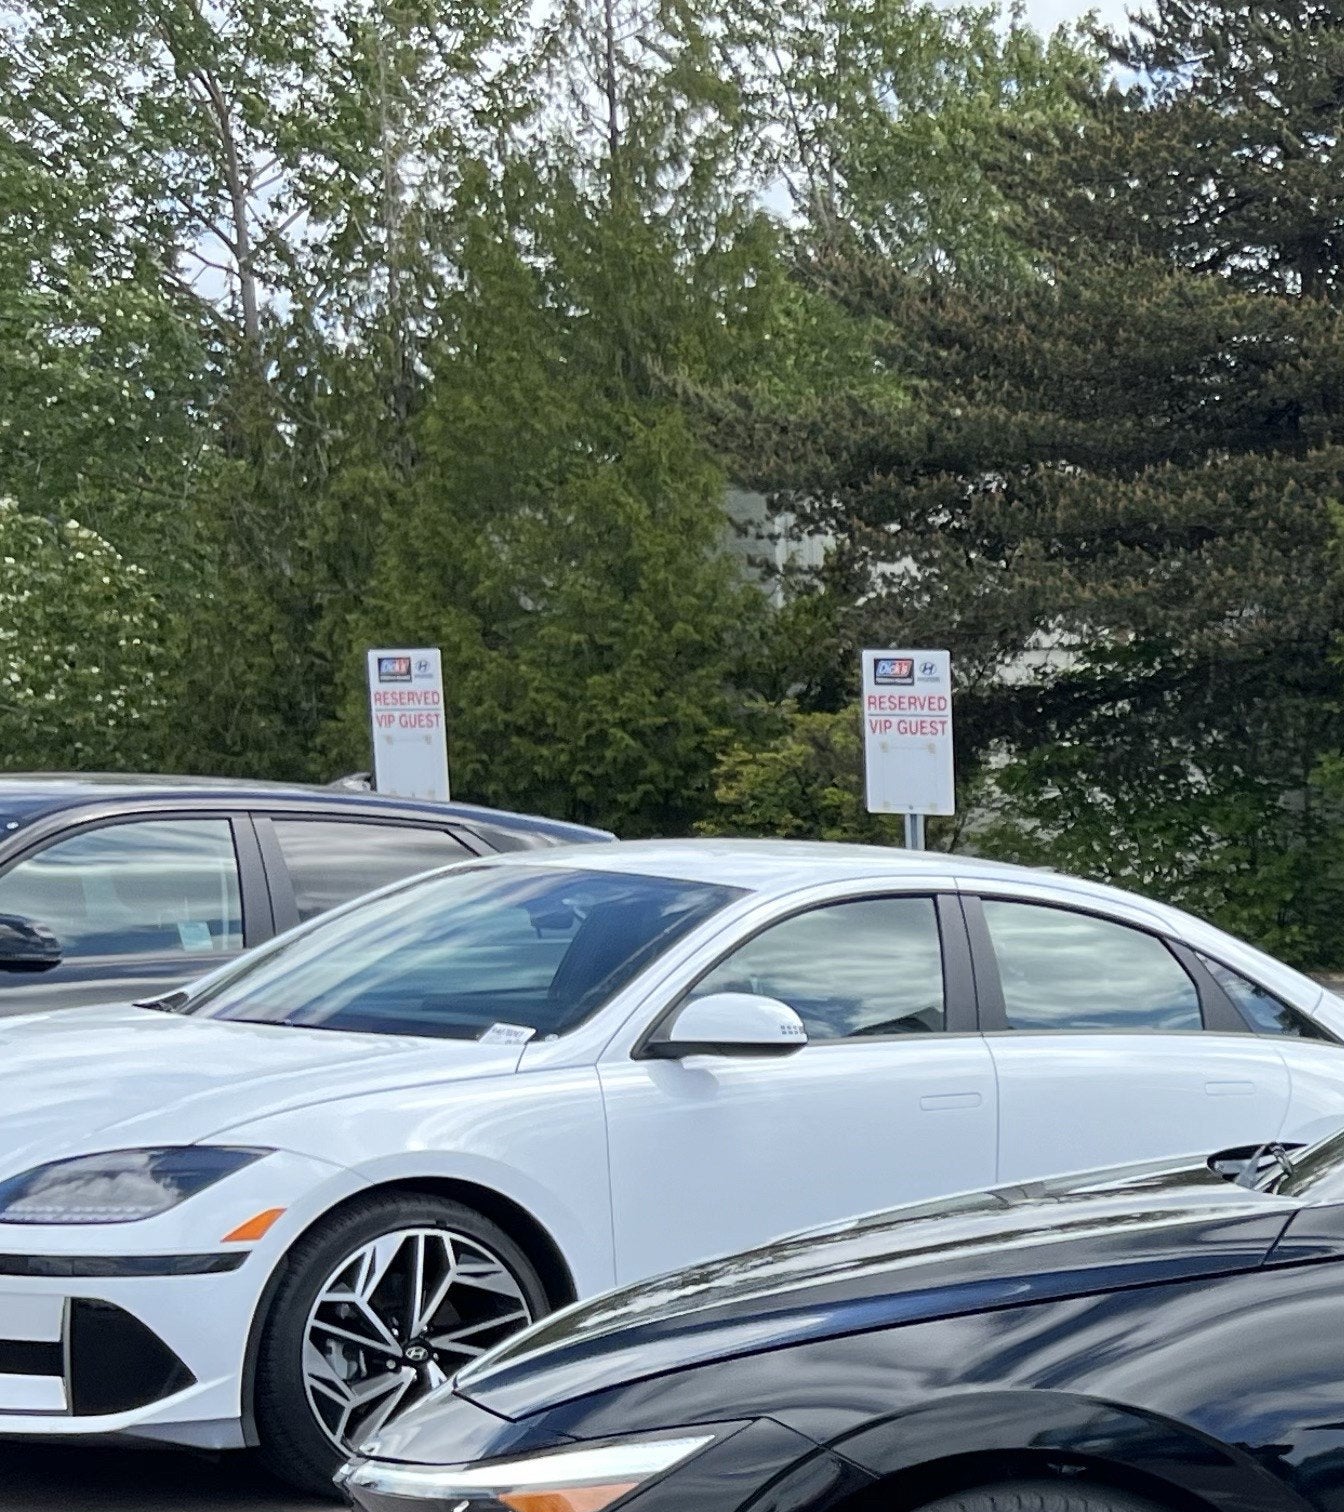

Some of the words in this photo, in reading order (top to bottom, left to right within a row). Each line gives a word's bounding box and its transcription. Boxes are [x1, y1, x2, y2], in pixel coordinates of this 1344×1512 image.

[374, 690, 440, 706] RESERVED
[867, 694, 947, 711] RESERVED
[375, 713, 395, 728] VIP
[399, 713, 440, 728] GUEST
[869, 719, 892, 735] VIP
[897, 719, 948, 736] GUEST
